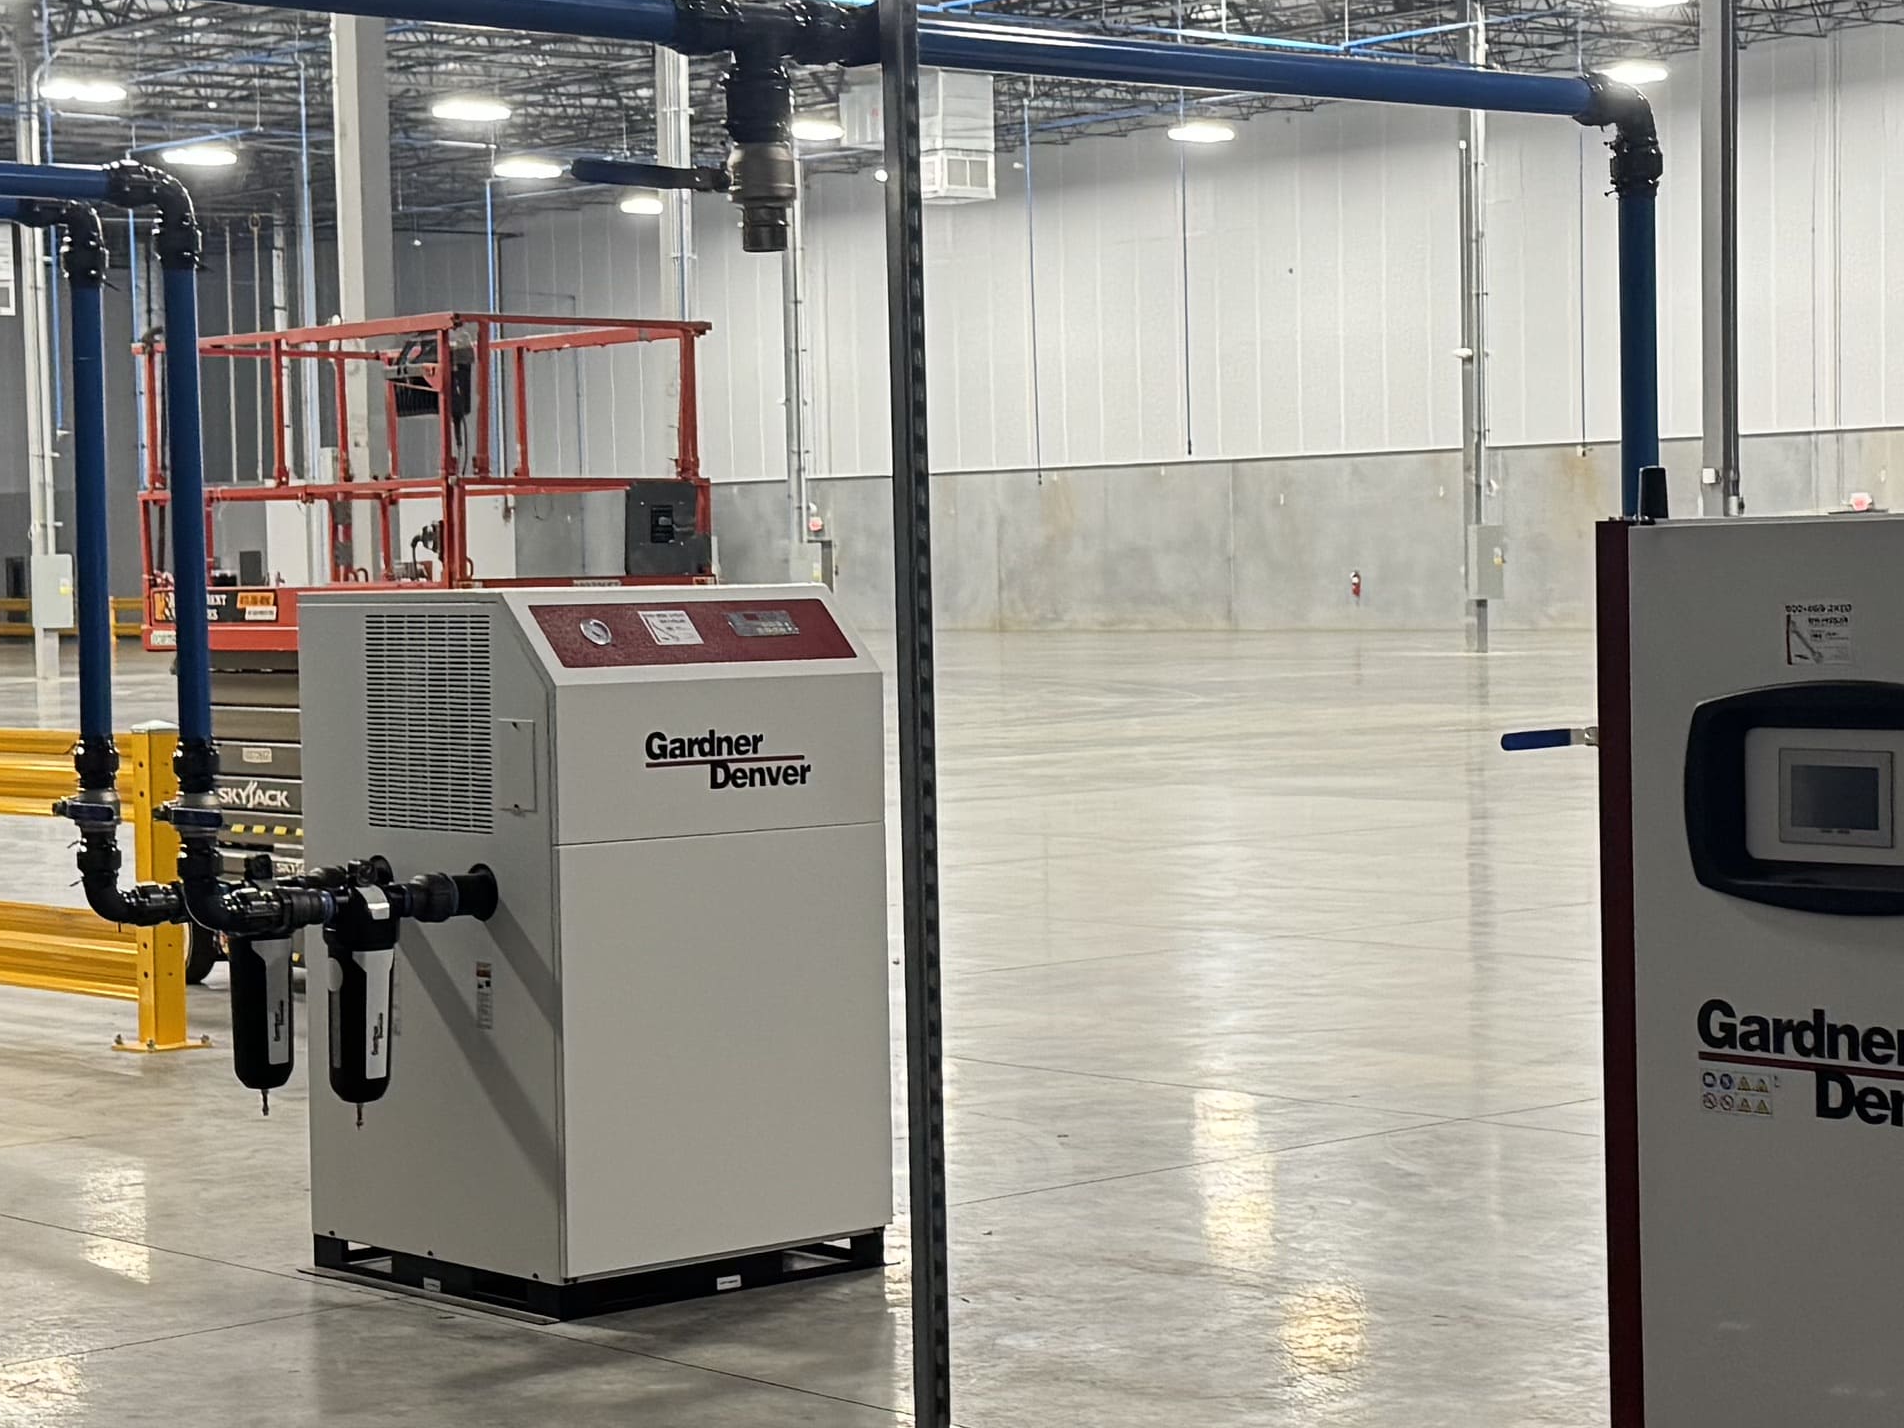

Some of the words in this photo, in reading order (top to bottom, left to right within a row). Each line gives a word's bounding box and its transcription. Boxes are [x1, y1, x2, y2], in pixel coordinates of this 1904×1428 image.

[645, 729, 764, 760] Gardner
[709, 762, 812, 790] Denver
[218, 780, 290, 808] SKYJACK
